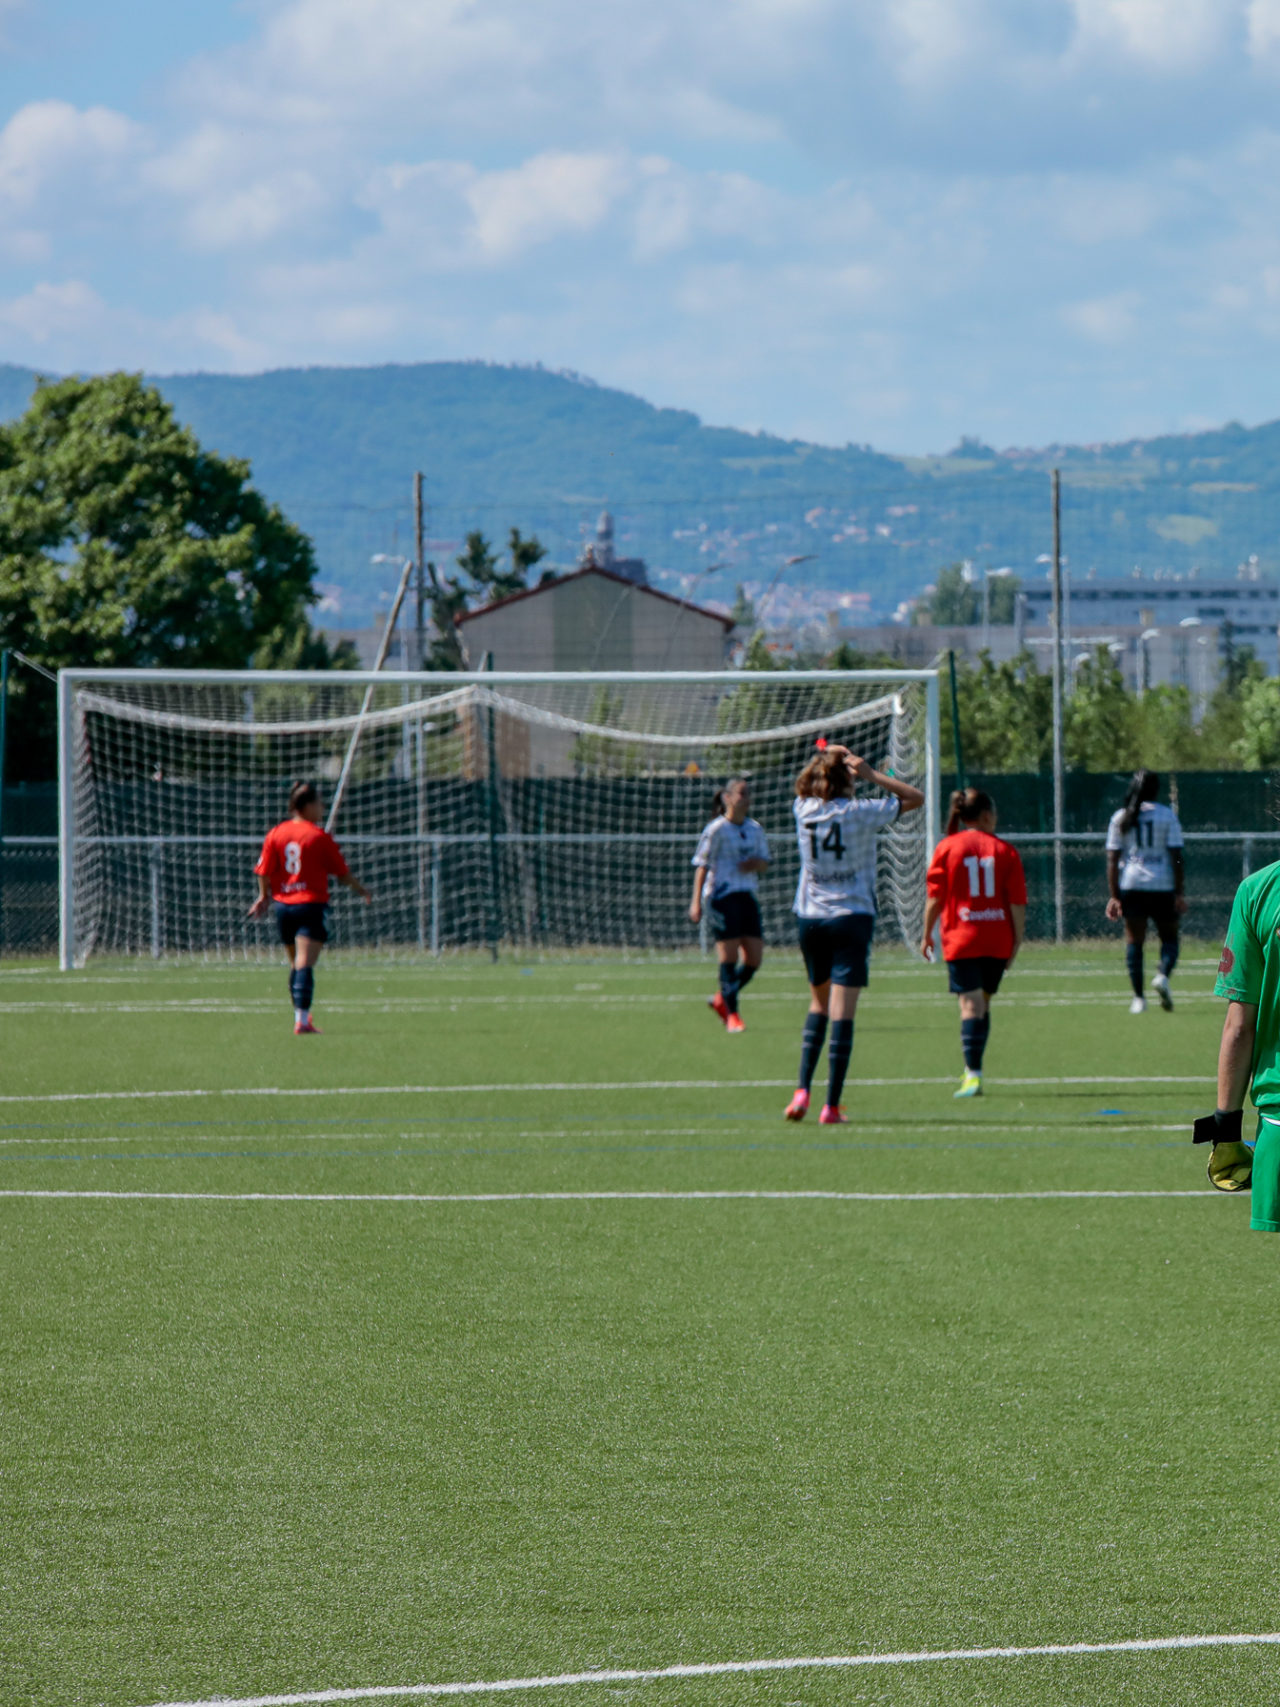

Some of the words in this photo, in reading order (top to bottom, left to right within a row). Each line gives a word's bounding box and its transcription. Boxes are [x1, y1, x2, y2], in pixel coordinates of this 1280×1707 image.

[284, 841, 301, 875] 8
[805, 821, 846, 860] 14
[963, 856, 996, 898] 11
